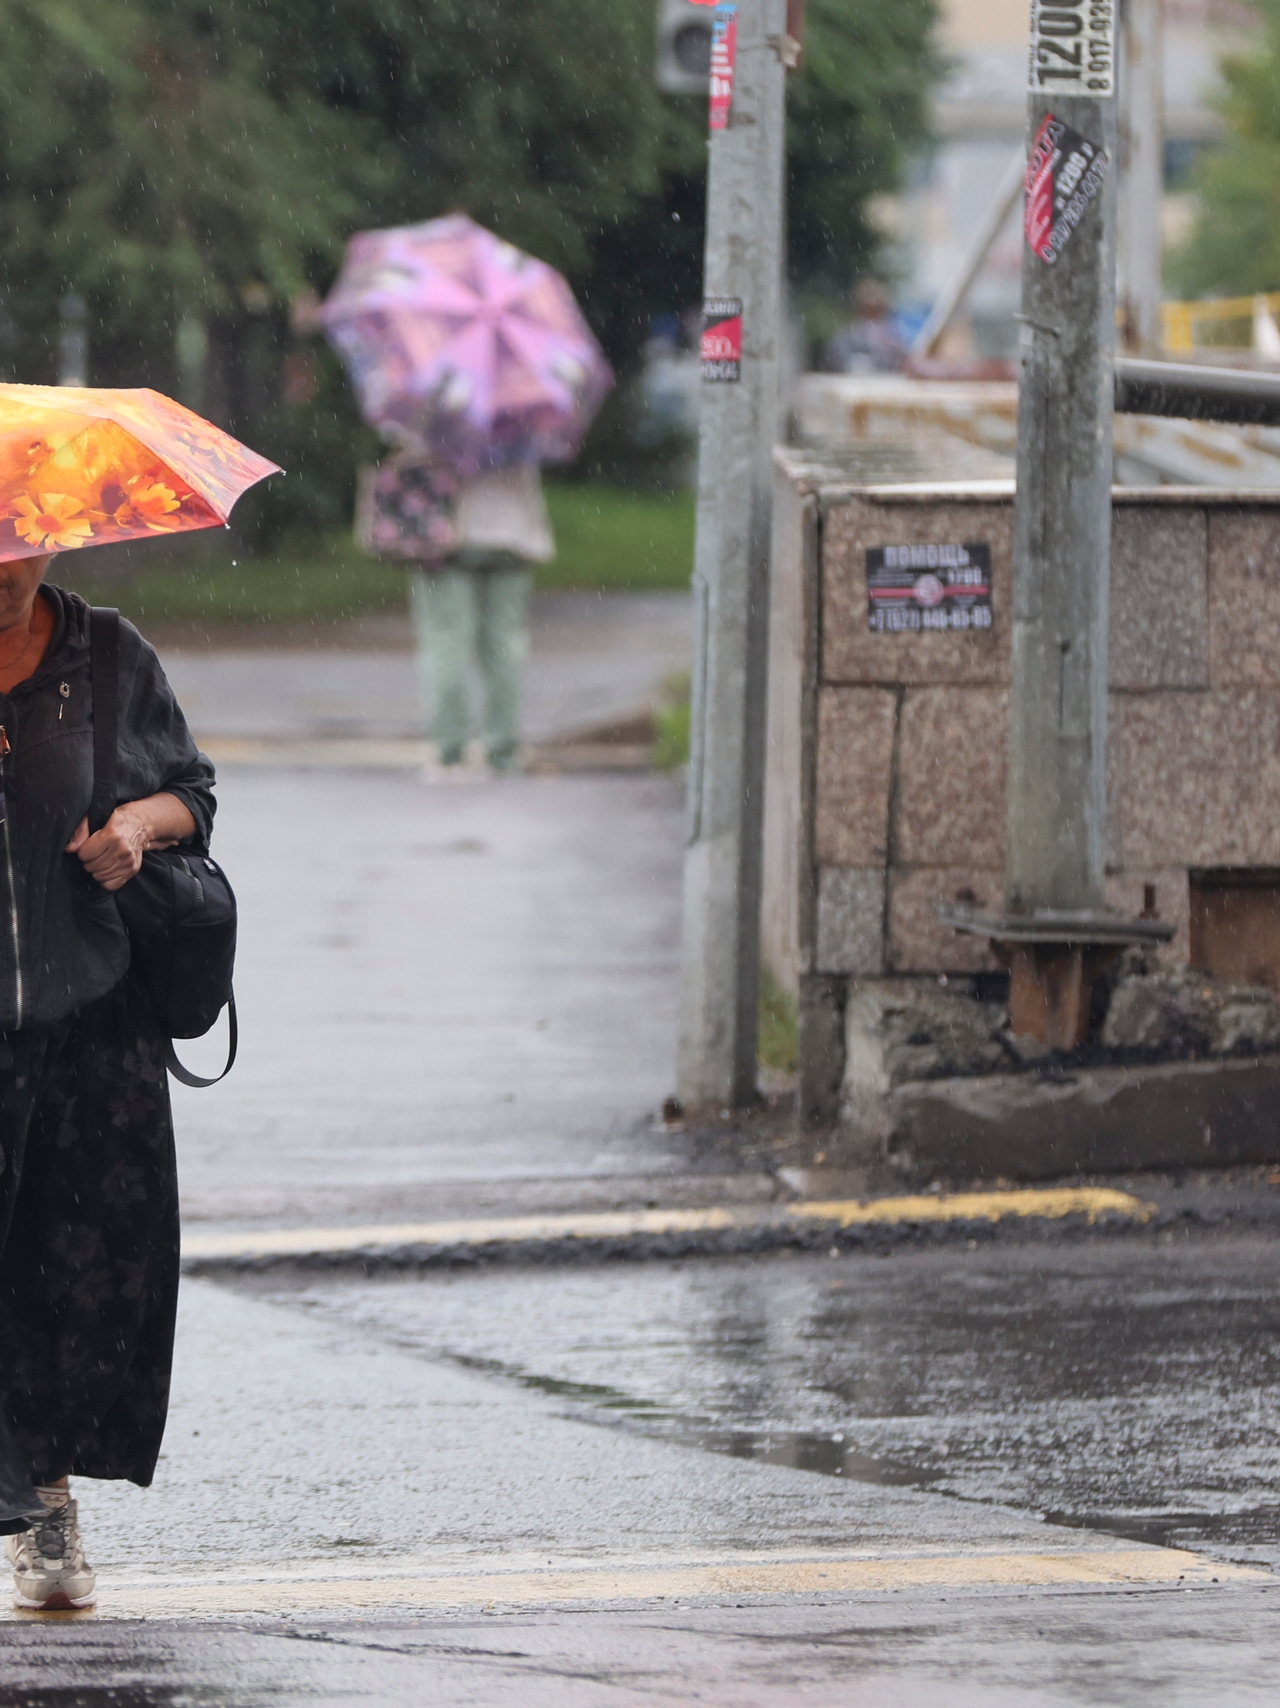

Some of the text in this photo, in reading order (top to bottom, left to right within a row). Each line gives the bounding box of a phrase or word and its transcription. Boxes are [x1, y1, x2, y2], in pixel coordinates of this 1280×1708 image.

[1087, 0, 1112, 90] 8 917-93
[1056, 151, 1087, 196] 1200
[884, 545, 970, 568] ПОМОЩЬ
